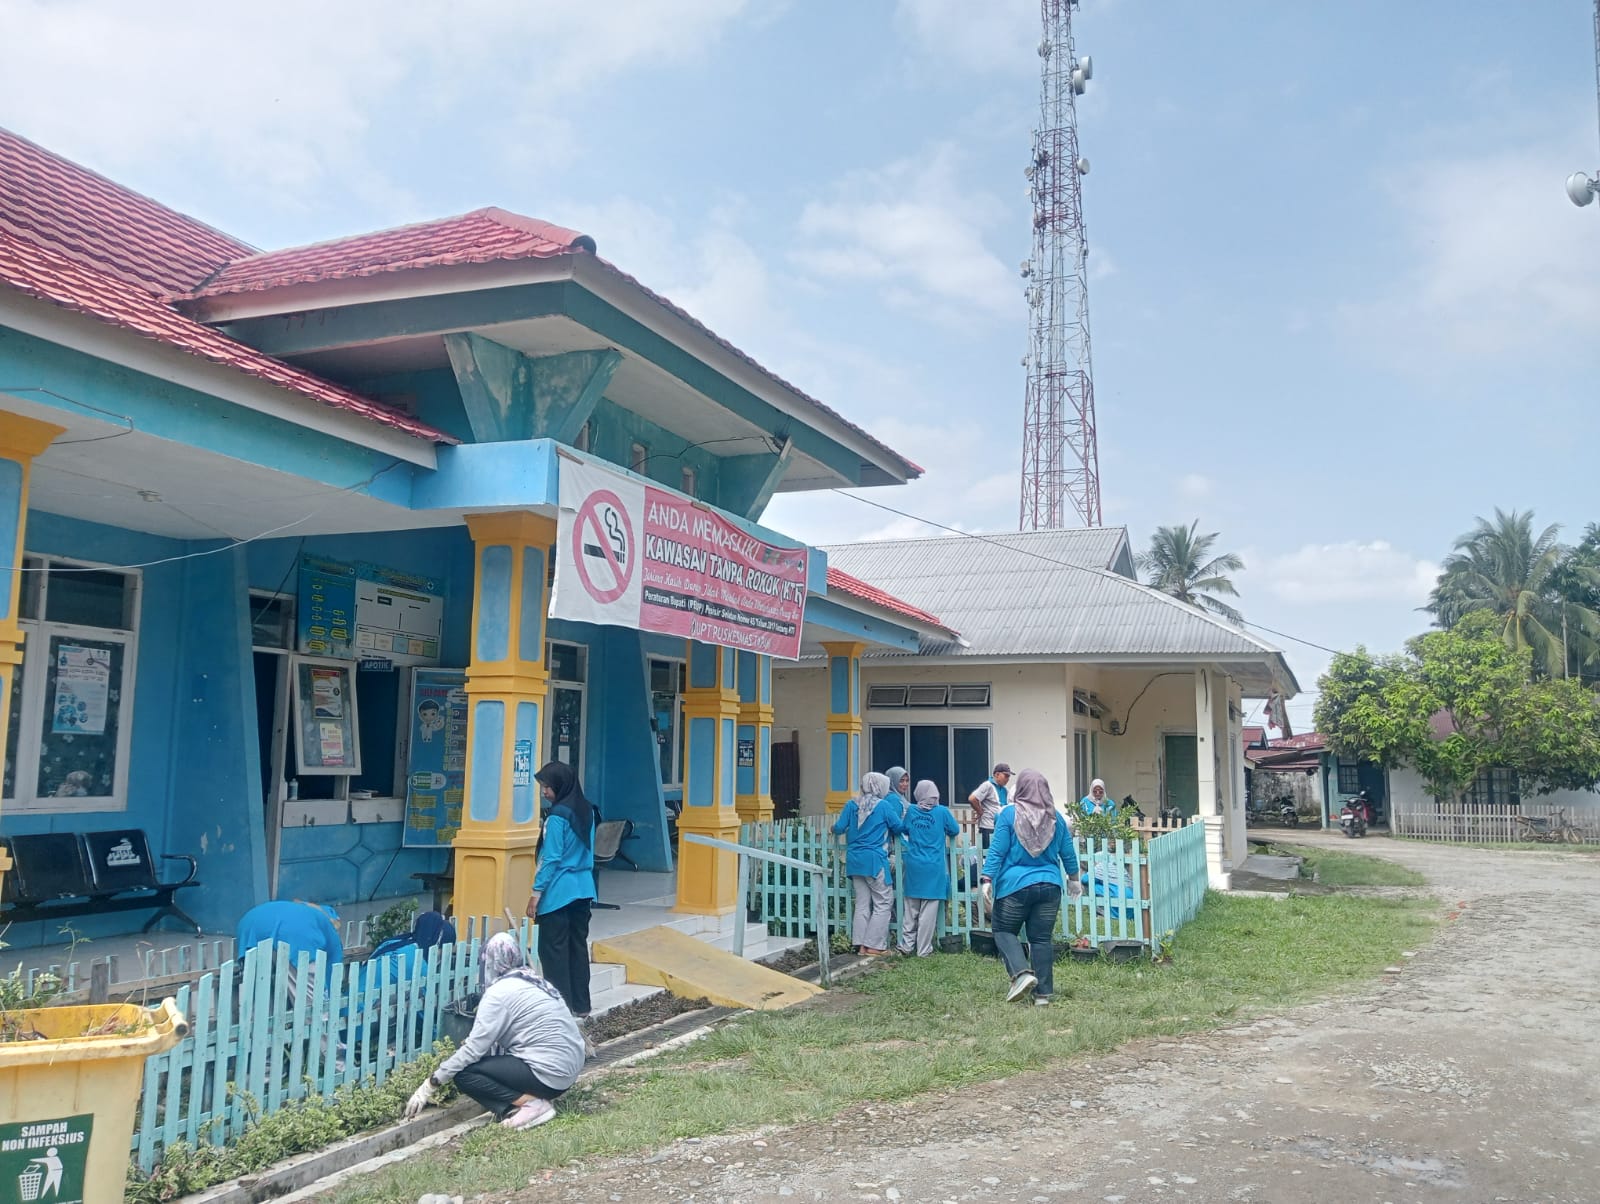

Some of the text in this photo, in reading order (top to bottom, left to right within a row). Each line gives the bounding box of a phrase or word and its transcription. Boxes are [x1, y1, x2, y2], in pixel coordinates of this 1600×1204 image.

[648, 500, 761, 561] ANDA MEMASUKI
[709, 553, 744, 587] TANPA
[745, 566, 781, 598] ROKOK
[644, 590, 670, 604] Peraturan
[670, 595, 686, 608] Bupati
[21, 1122, 68, 1137] SAMPAH
[2, 1131, 85, 1151] NON INFEKSIUS
